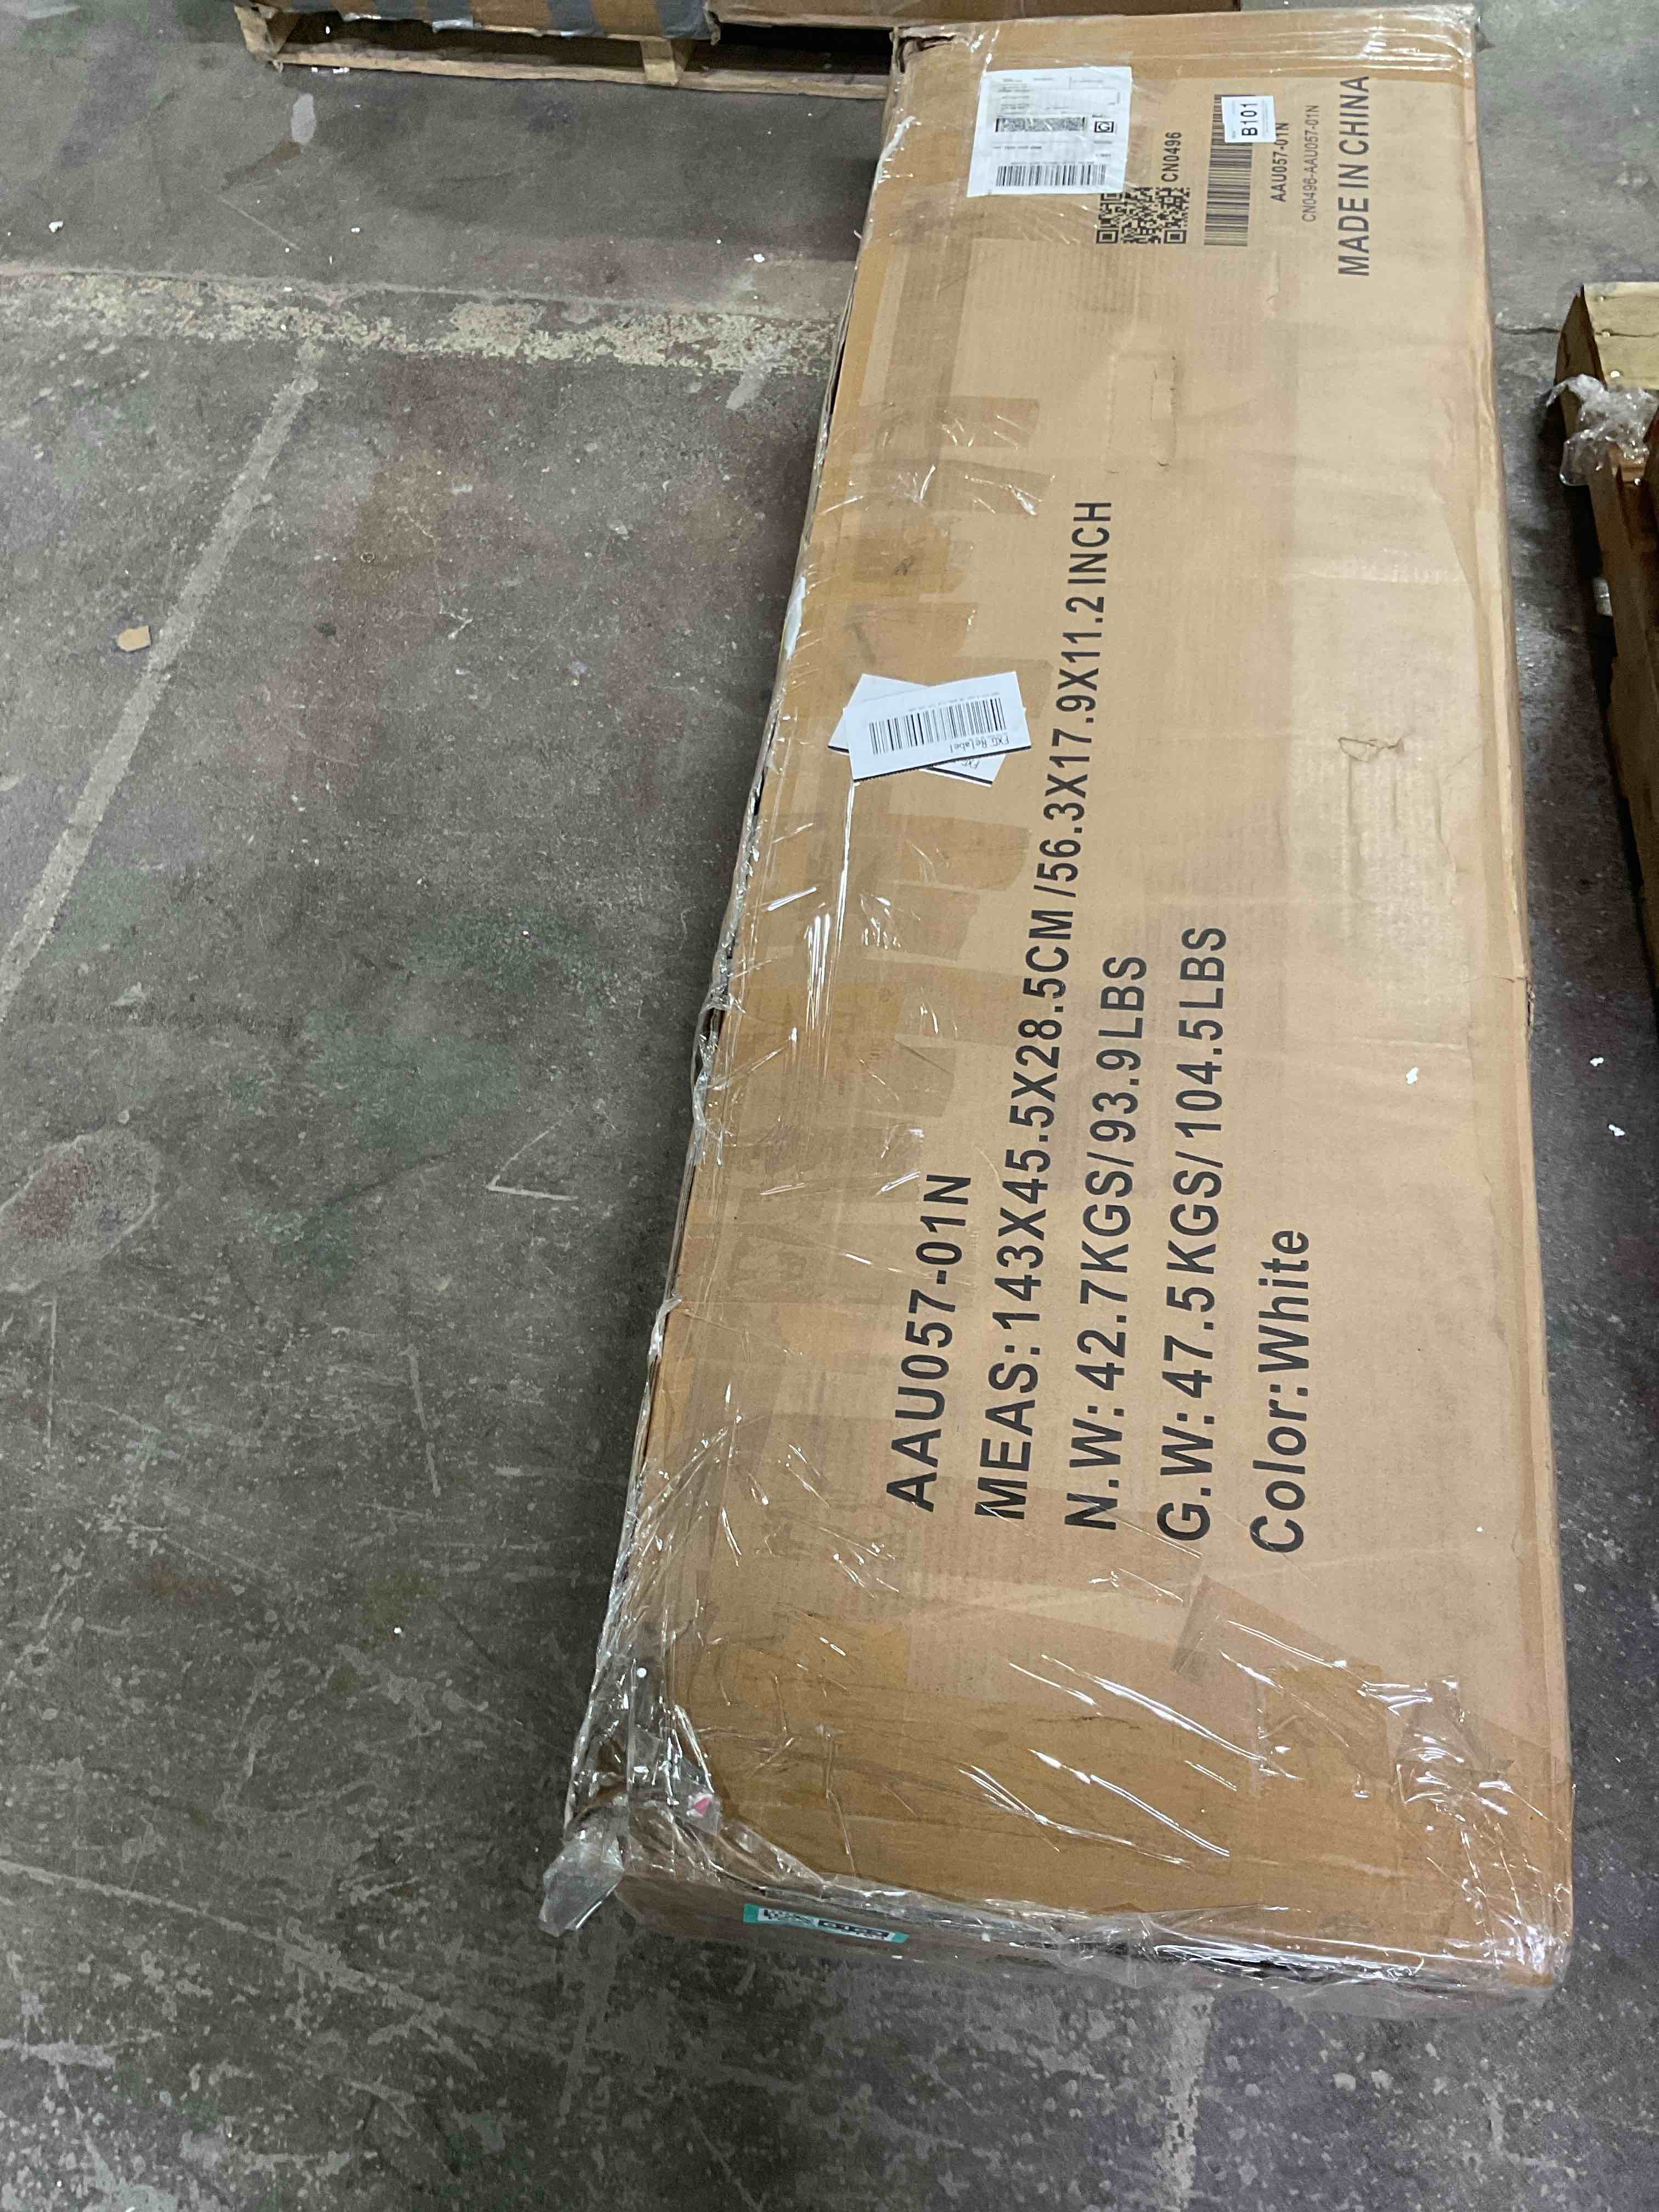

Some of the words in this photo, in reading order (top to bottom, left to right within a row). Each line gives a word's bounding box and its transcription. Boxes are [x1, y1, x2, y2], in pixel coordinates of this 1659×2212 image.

[1240, 103, 1258, 137] B101
[1338, 76, 1369, 155] CHINA
[1161, 132, 1182, 182] CN0496
[1270, 122, 1290, 202] AAU057-01N
[1301, 105, 1320, 222] CN0496-AAU057-01N
[1338, 163, 1369, 189] IN
[1338, 196, 1370, 276] MADE
[950, 738, 988, 753] Relabel
[885, 1174, 972, 1513] AAU057-01N
